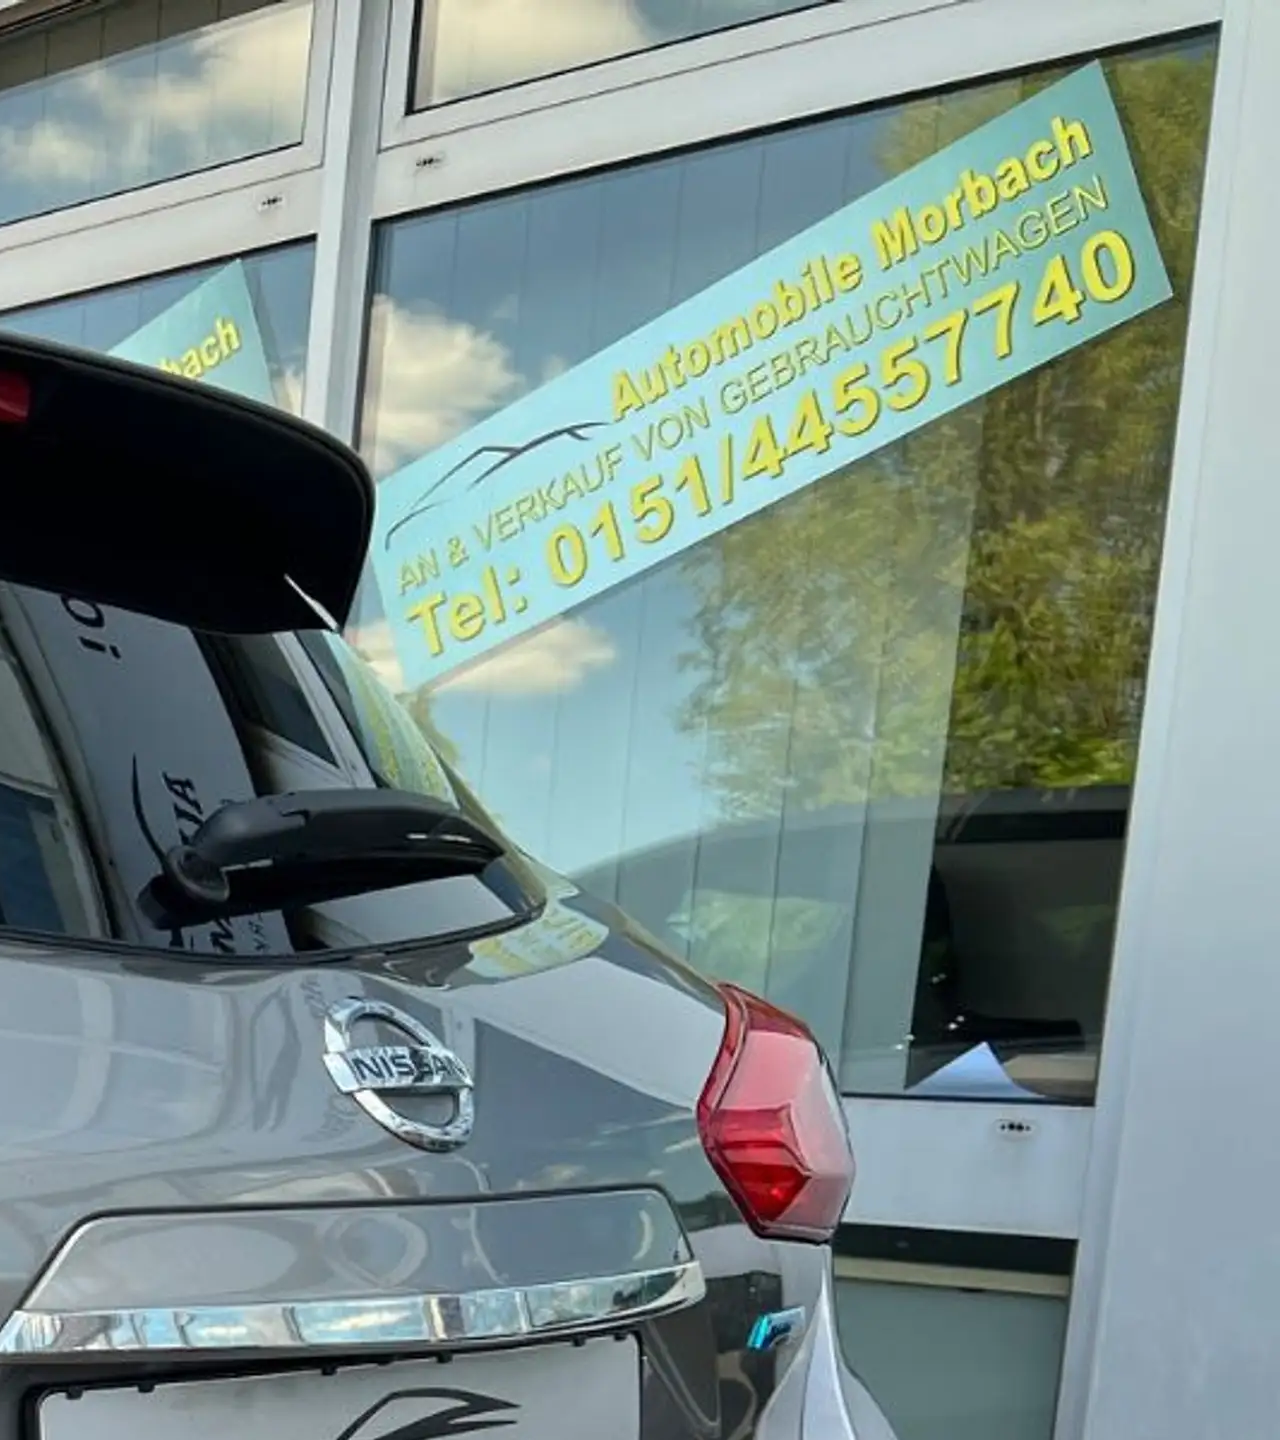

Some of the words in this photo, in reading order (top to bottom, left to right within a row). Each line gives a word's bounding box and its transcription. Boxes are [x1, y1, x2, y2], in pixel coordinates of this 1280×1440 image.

[398, 550, 440, 596] AN
[447, 535, 470, 568] &
[473, 444, 628, 552] VERKAUF
[630, 396, 712, 463] VON
[718, 174, 1111, 416] GEBRAUCHTWAGEN
[406, 565, 529, 658] Tel:
[546, 229, 1137, 588] 0151/44557740
[611, 251, 864, 421] Automobile
[870, 116, 1094, 275] Morbach
